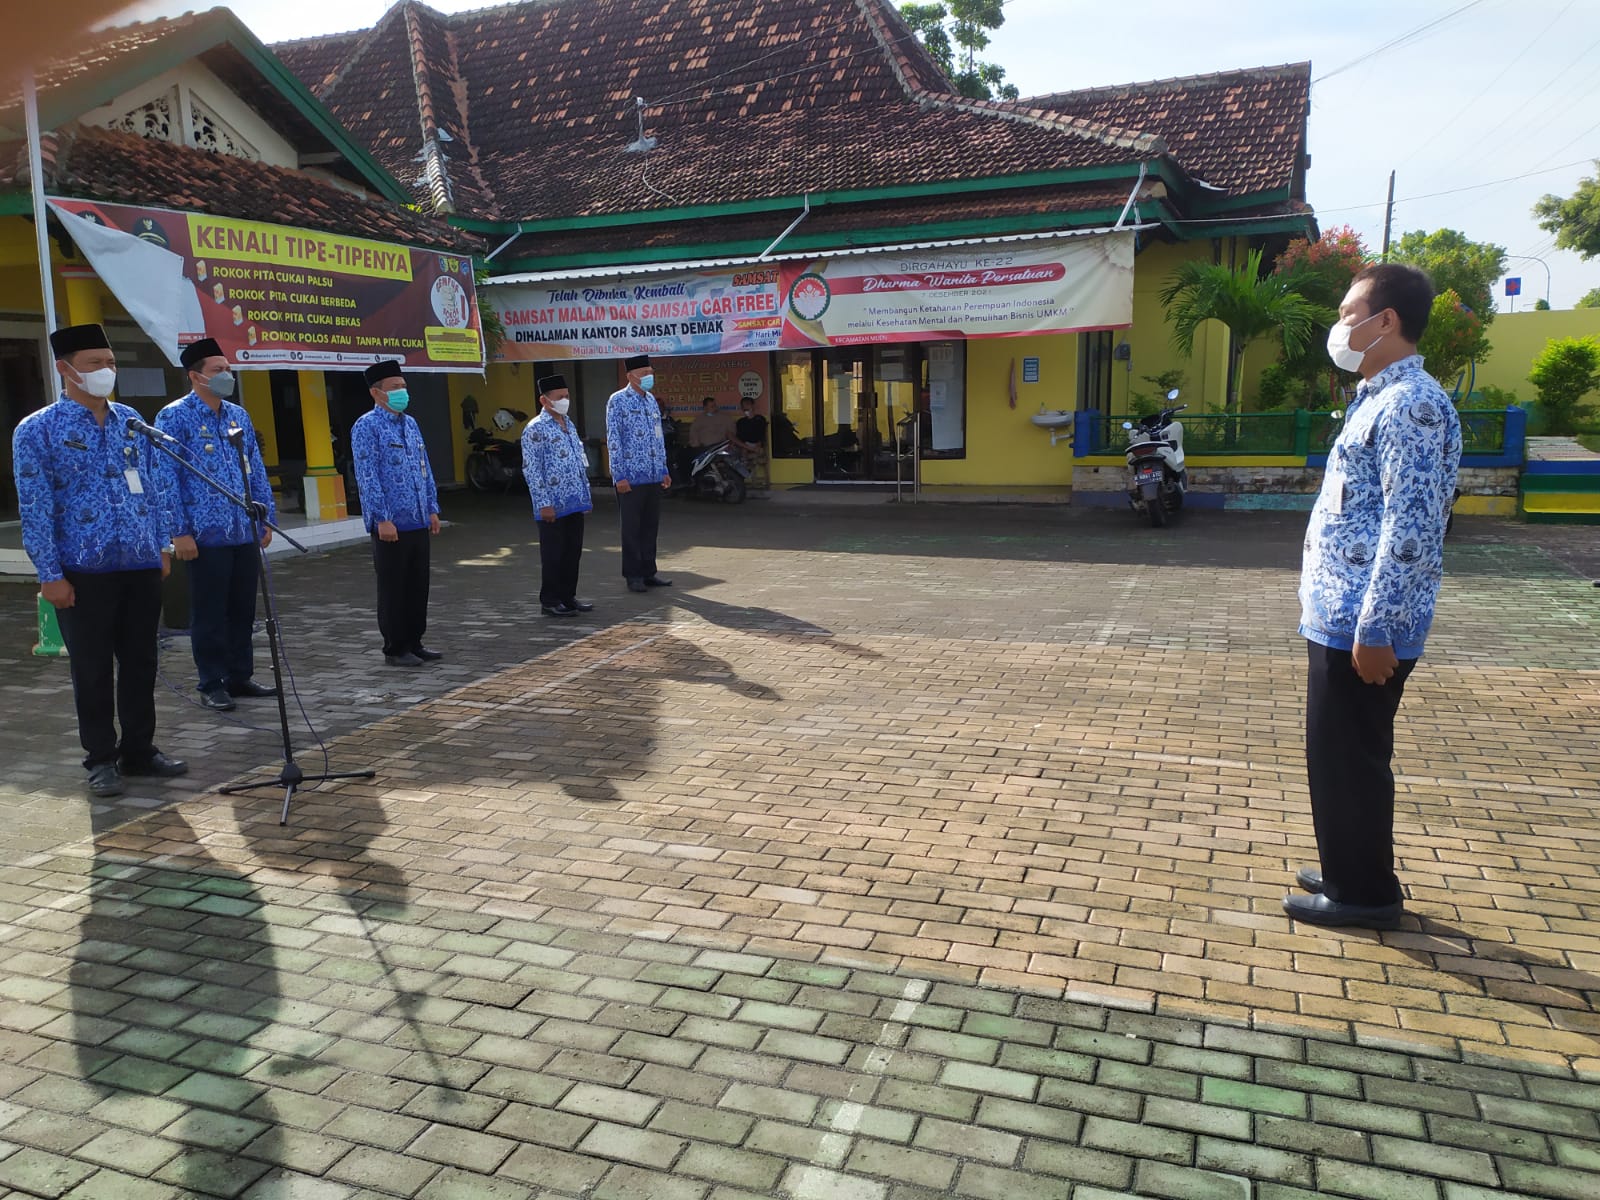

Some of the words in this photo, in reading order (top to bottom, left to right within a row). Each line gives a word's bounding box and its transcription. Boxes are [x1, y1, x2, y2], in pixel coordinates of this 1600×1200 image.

[197, 225, 278, 256] KENALI
[285, 236, 408, 273] TIPE-TIPENYA
[900, 261, 968, 272] DIRGAHAYU
[975, 257, 1013, 267] KE-22
[213, 267, 251, 279] ROKOK
[253, 270, 275, 281] PITA
[276, 272, 304, 284] CUKAI
[308, 275, 333, 288] PALSU
[732, 271, 779, 287] SAMSAT
[863, 277, 921, 292] Dharma
[924, 273, 977, 287] Wanita
[981, 268, 1054, 284] Persatuan
[229, 289, 265, 300] ROKOK
[269, 291, 287, 302] PITA
[290, 293, 318, 305] CUKAI
[321, 296, 356, 308] BERBEDA
[546, 289, 578, 304] Telah
[582, 288, 627, 302] Dibuka
[634, 283, 685, 300] Kembali
[504, 308, 555, 326] SAMSAT
[558, 306, 605, 323] MALAM
[609, 304, 637, 321] DAN
[641, 300, 697, 319] SAMSAT
[702, 297, 732, 315] CAR
[736, 294, 774, 312] FREE
[920, 304, 961, 313] Ketahanan
[964, 302, 1010, 311] Perempuan
[1013, 298, 1055, 307] Indonesia
[248, 311, 282, 321] ROKOK
[285, 312, 304, 323] PITA
[307, 314, 333, 325] CUKAI
[335, 316, 361, 327] BEKAS
[737, 320, 765, 328] SAMSAT
[767, 318, 781, 326] CAR
[876, 319, 917, 327] Kesehatan
[919, 316, 946, 325] Mental
[965, 313, 1008, 322] Pemulihan
[1010, 311, 1034, 320] Bisnis
[516, 328, 578, 342] DIHALAMAN
[582, 326, 627, 339] KANTOR
[631, 323, 677, 337] SAMSAT
[681, 320, 724, 335] DEMAK
[755, 331, 770, 339] Hari
[261, 331, 296, 342] ROKOK
[299, 332, 329, 343] POLOS
[331, 335, 351, 344] ATAU
[356, 336, 382, 346] TANPA
[384, 337, 400, 347] PITA
[402, 339, 424, 348] CUKAI
[573, 345, 595, 355] Mulai
[599, 345, 609, 354] 01
[612, 345, 636, 353] Maret
[639, 344, 660, 353] 2021
[655, 371, 729, 384] PATEN
